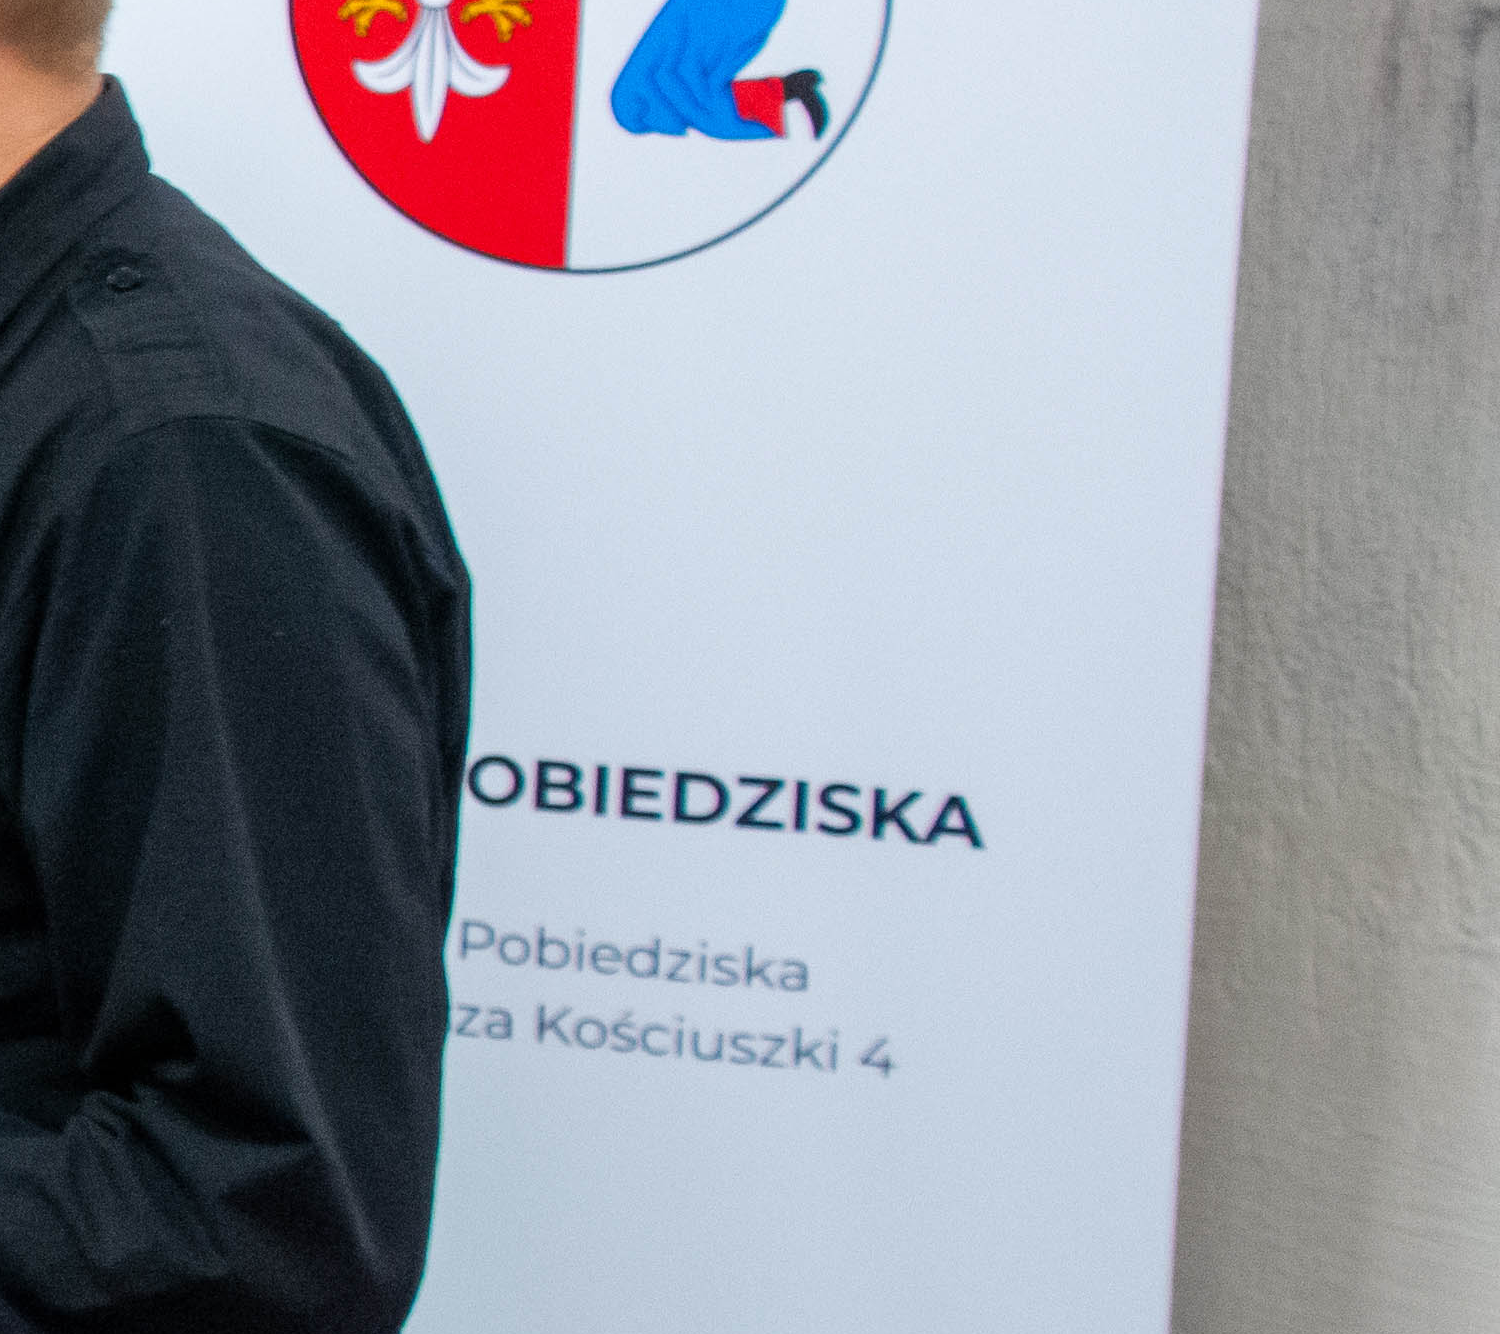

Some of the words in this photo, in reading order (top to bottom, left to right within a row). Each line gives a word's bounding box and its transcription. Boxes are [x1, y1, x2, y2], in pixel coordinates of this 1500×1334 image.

[467, 754, 986, 851] OBIEDZISKA
[457, 918, 811, 993] Pobiedziska
[454, 1002, 514, 1040] za
[533, 1002, 840, 1072] Kościuszki
[857, 1035, 898, 1078] 4
